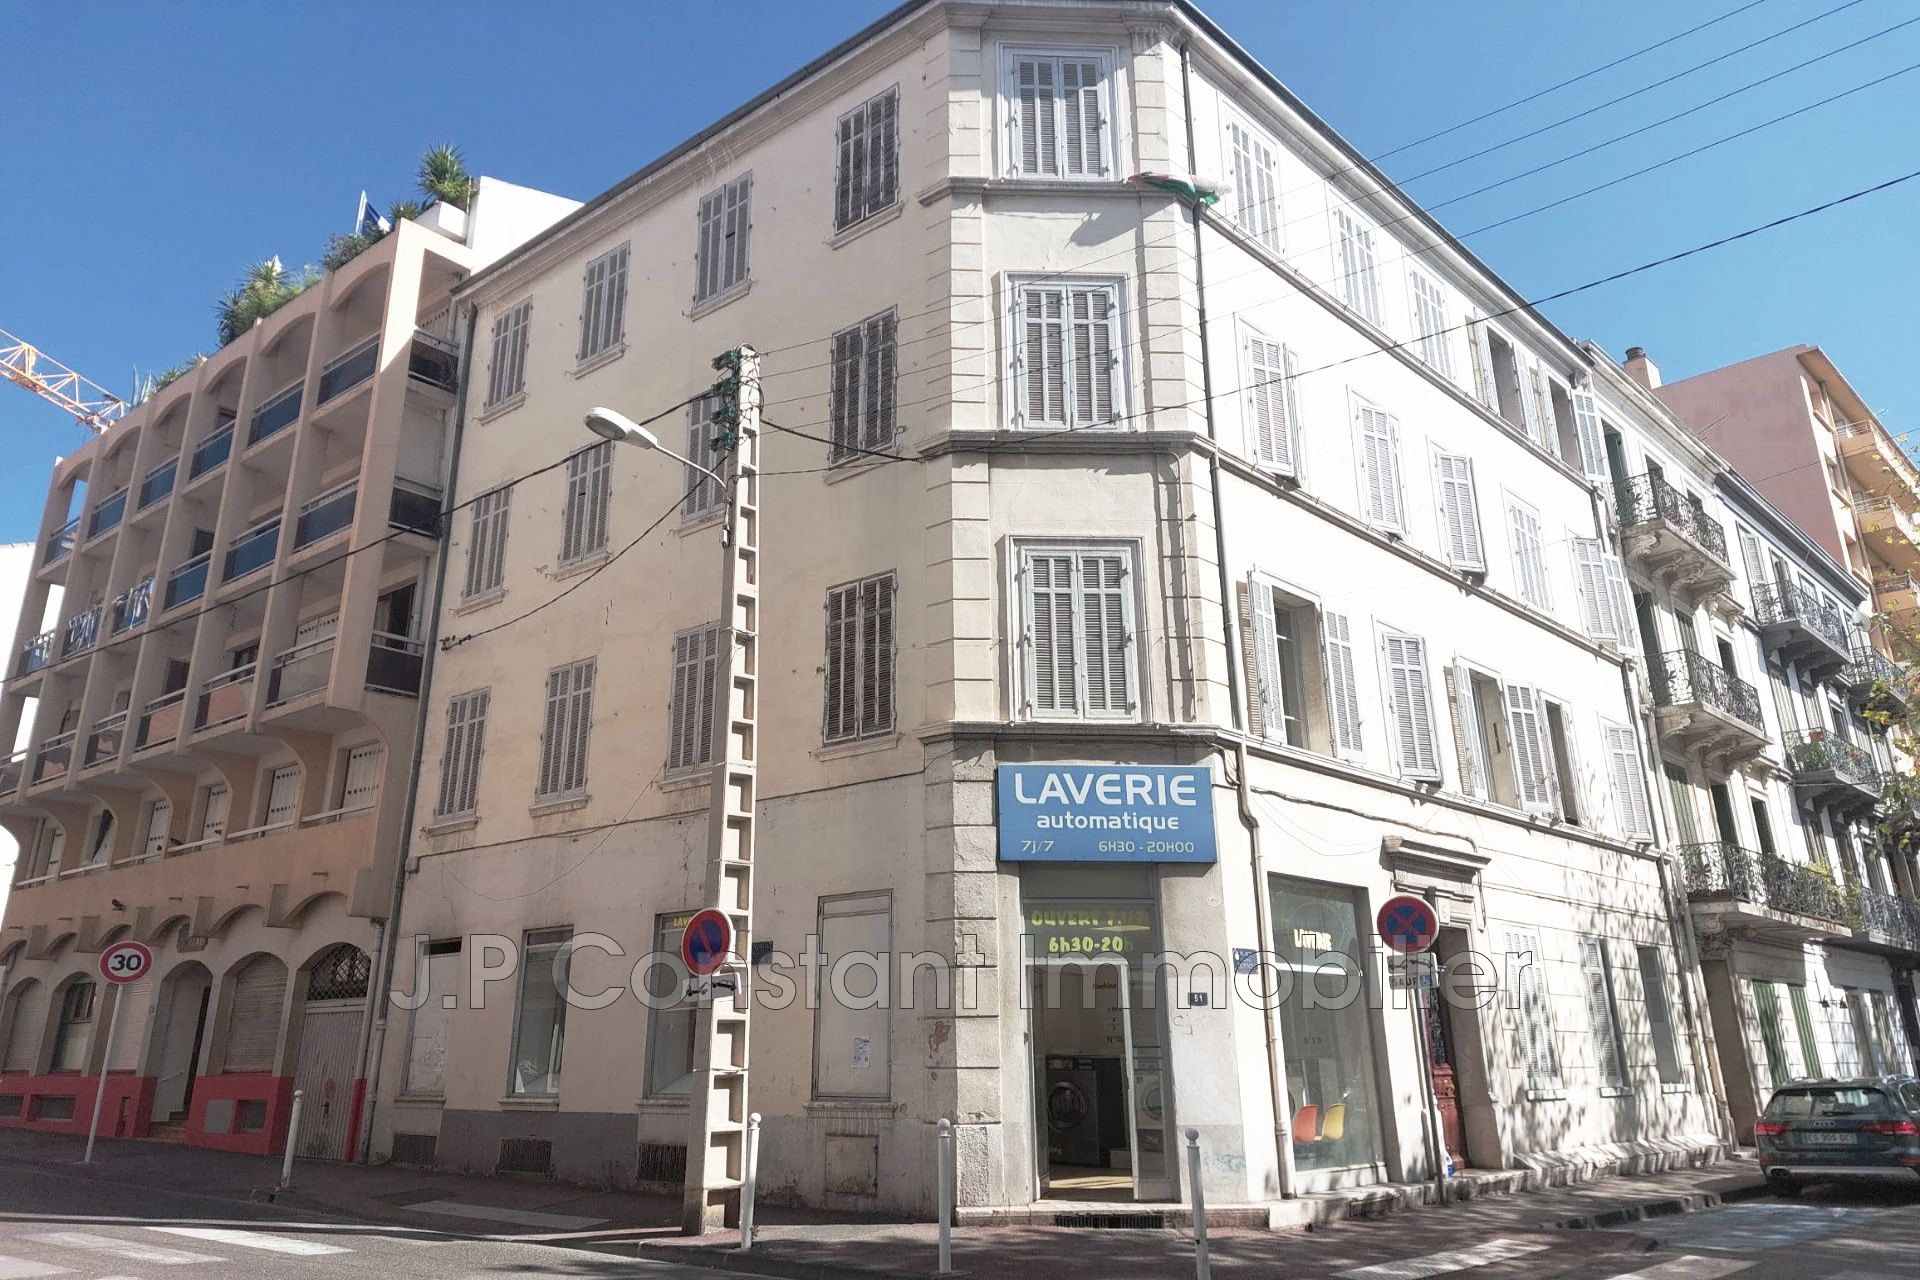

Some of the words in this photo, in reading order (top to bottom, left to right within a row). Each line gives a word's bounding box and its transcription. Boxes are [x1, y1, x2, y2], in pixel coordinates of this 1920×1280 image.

[1015, 773, 1197, 806] LAVERIE
[1037, 811, 1179, 833] automatique
[1021, 840, 1054, 854] 7j/7
[1098, 841, 1135, 853] 6H30
[1146, 841, 1195, 853] 20H00
[110, 954, 142, 971] 30
[1391, 977, 1418, 988] SAUF
[1193, 993, 1204, 1003] 51
